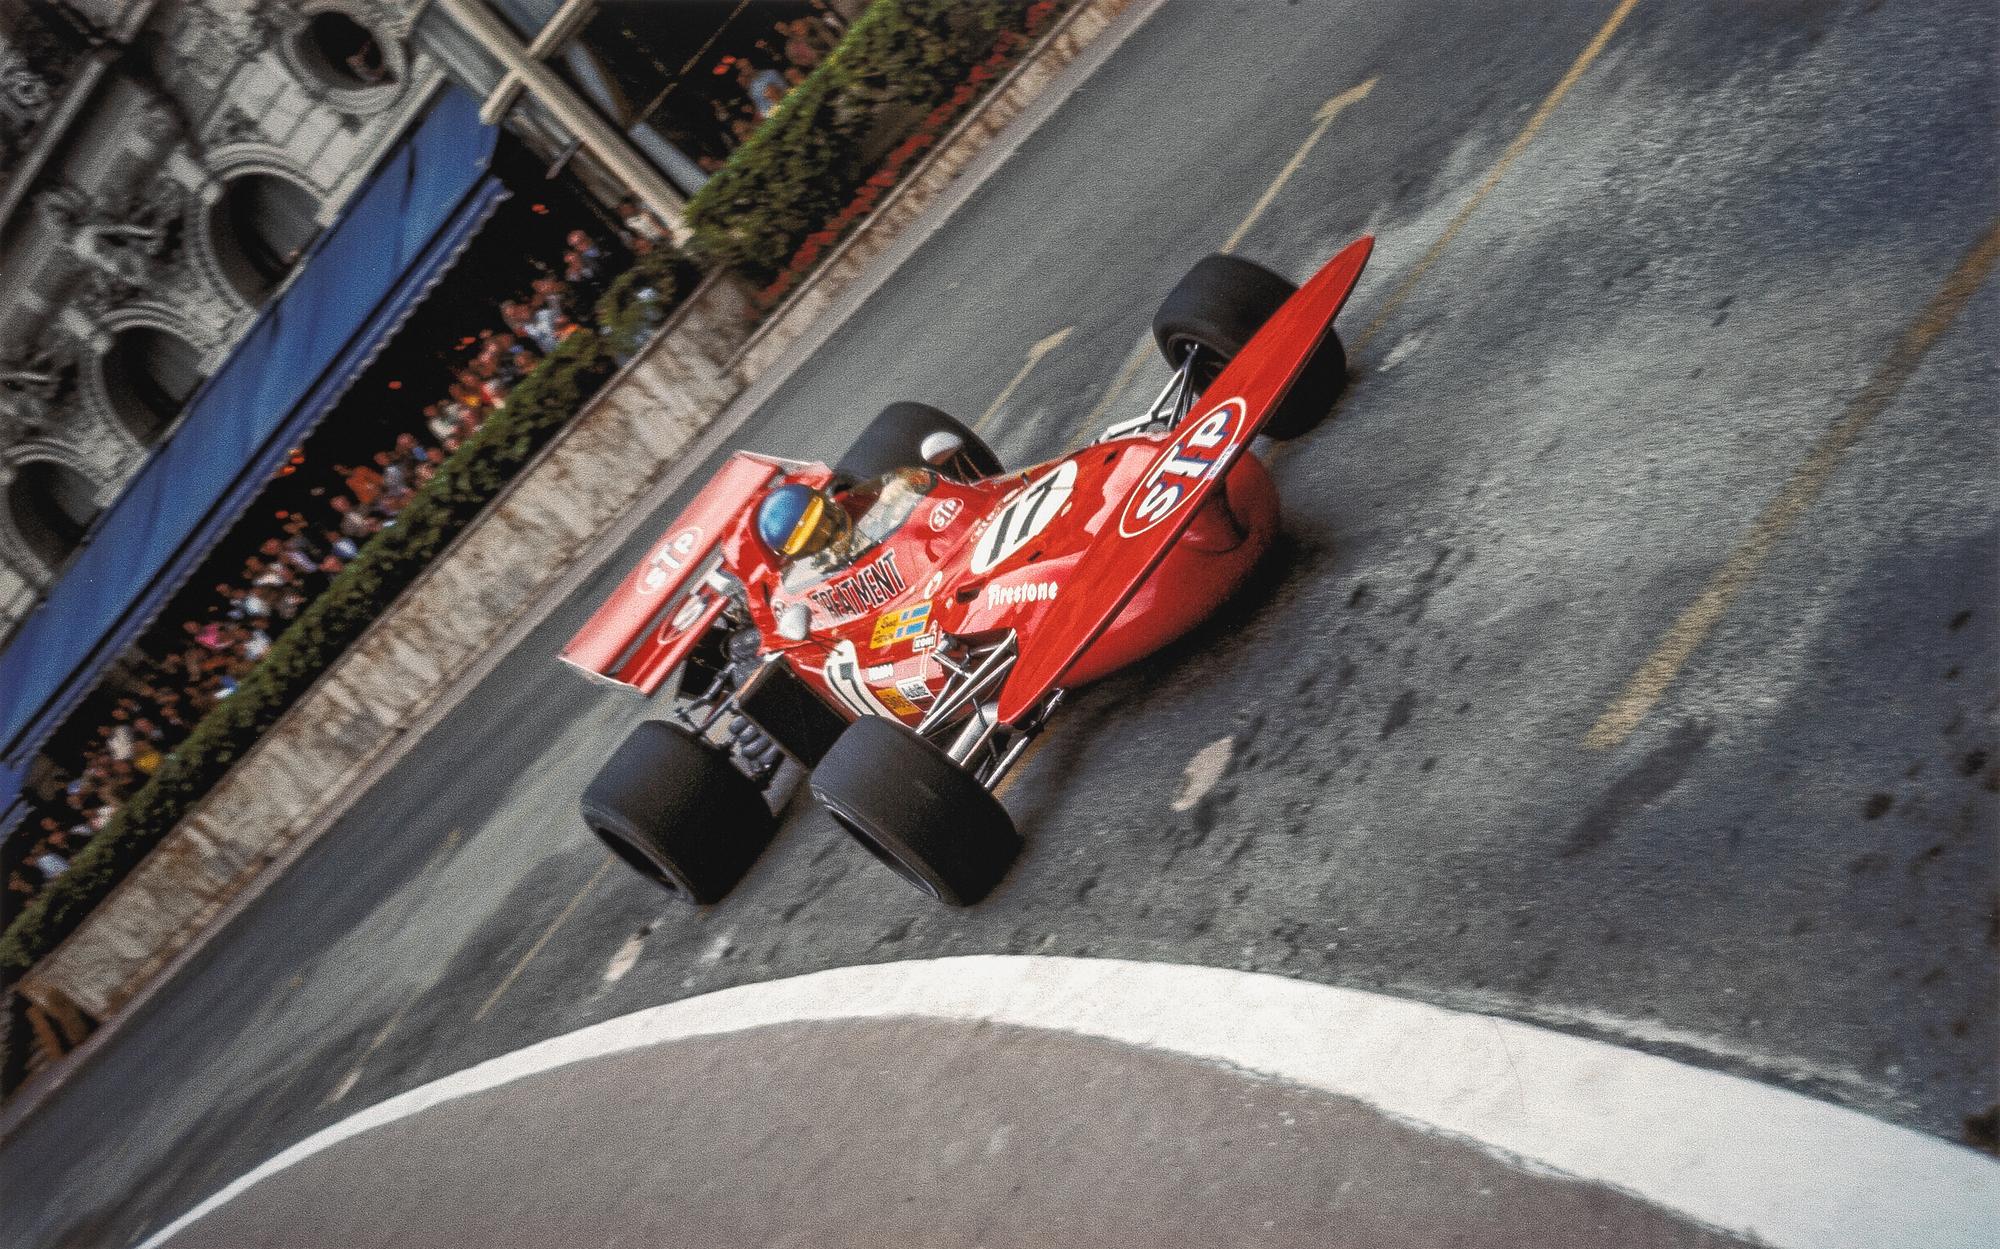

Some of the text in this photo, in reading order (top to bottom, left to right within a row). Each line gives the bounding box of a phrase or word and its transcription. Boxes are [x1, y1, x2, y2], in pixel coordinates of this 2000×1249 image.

[1136, 409, 1231, 522] STP
[933, 499, 957, 529] STP
[985, 468, 1061, 568] 17
[645, 532, 694, 589] STP
[672, 554, 731, 632] ST
[810, 551, 906, 618] TREATMENT
[987, 581, 1059, 611] Firestone
